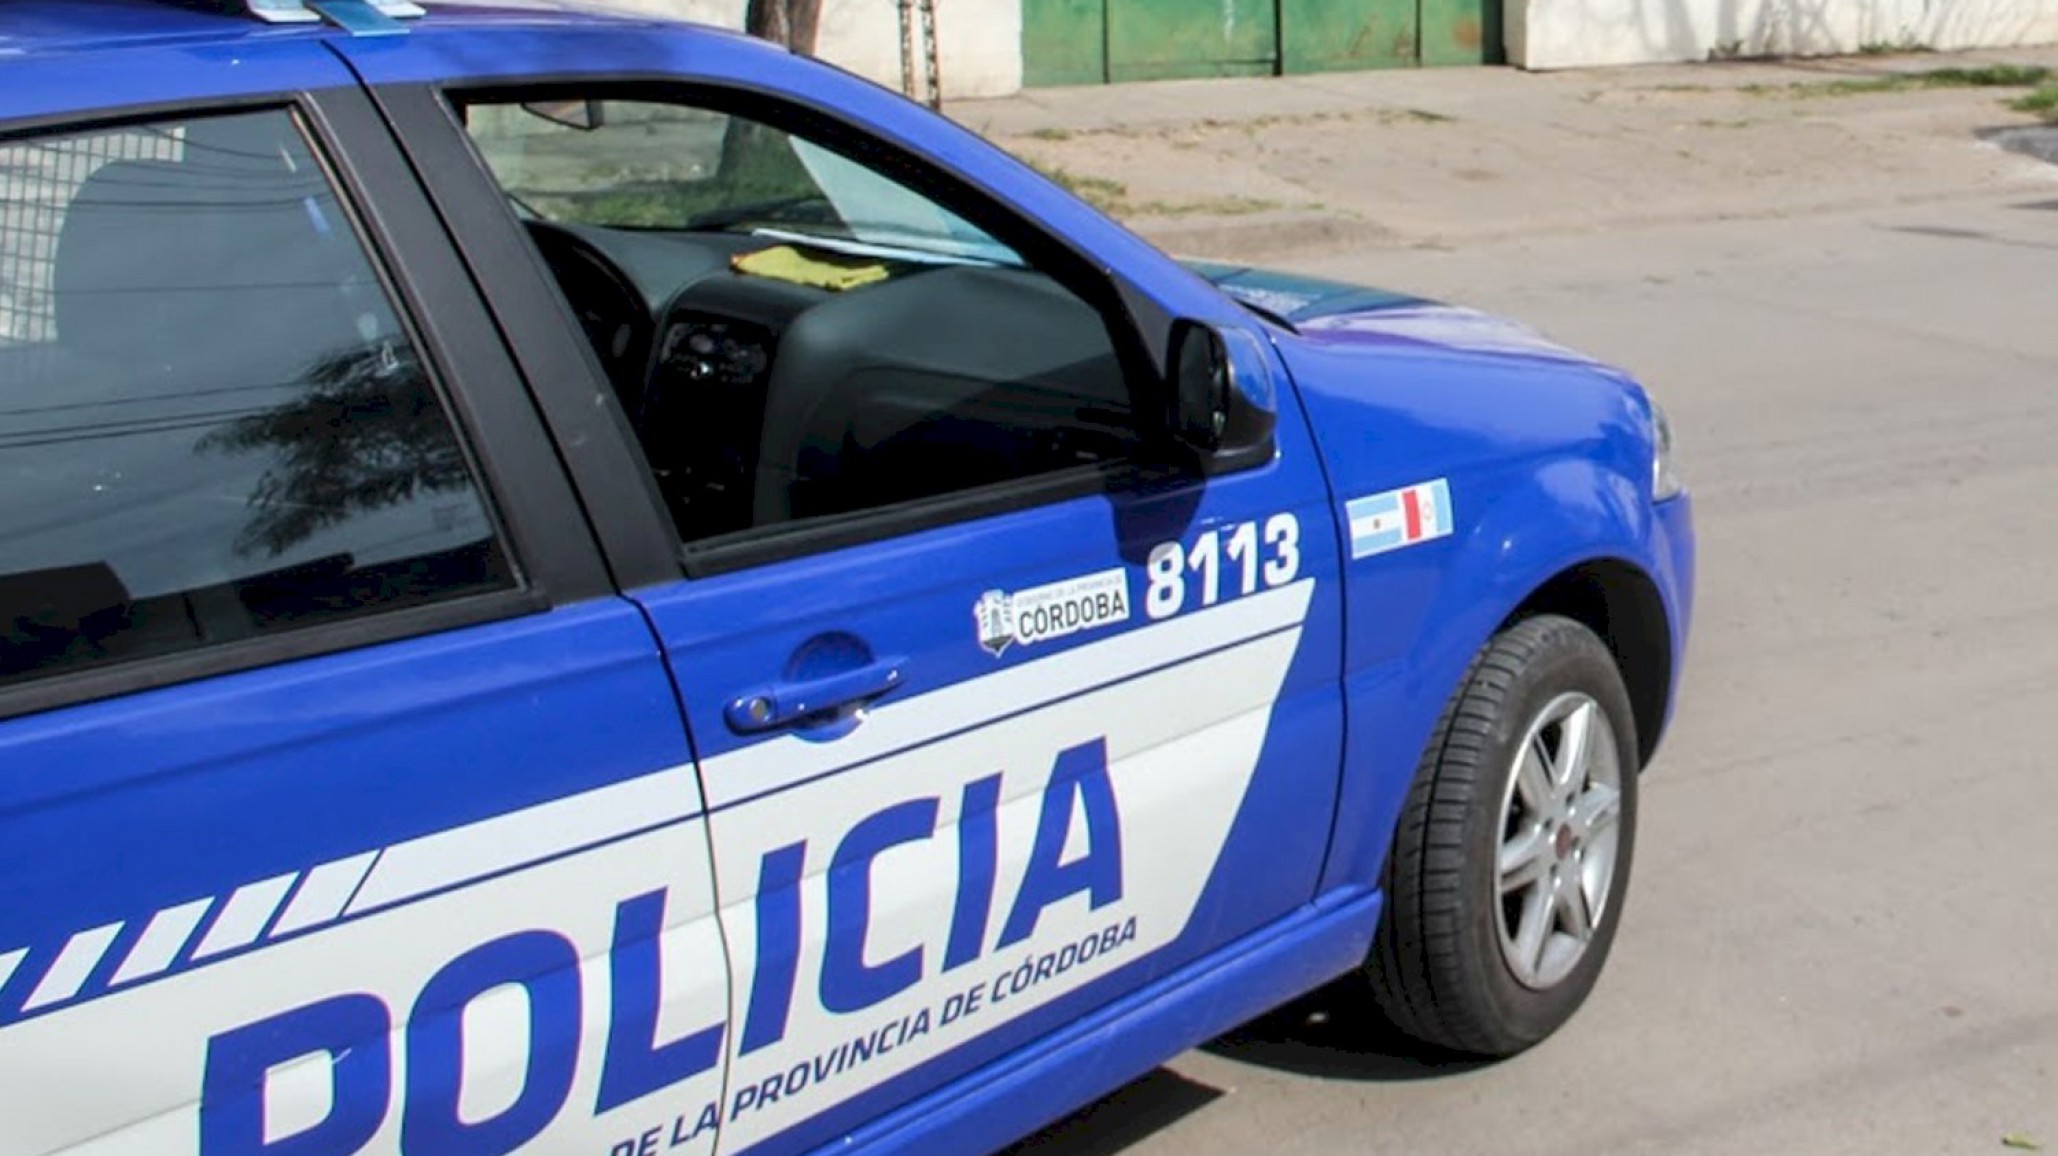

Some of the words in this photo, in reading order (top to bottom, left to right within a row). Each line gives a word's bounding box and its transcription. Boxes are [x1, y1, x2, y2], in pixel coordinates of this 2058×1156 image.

[1147, 512, 1299, 619] 8113
[200, 735, 1124, 1156] POLICIA
[669, 1101, 719, 1148] LA
[730, 1007, 930, 1122] PROVINCIA
[939, 982, 987, 1027] DE
[991, 916, 1137, 1003] CÓRDOBA
